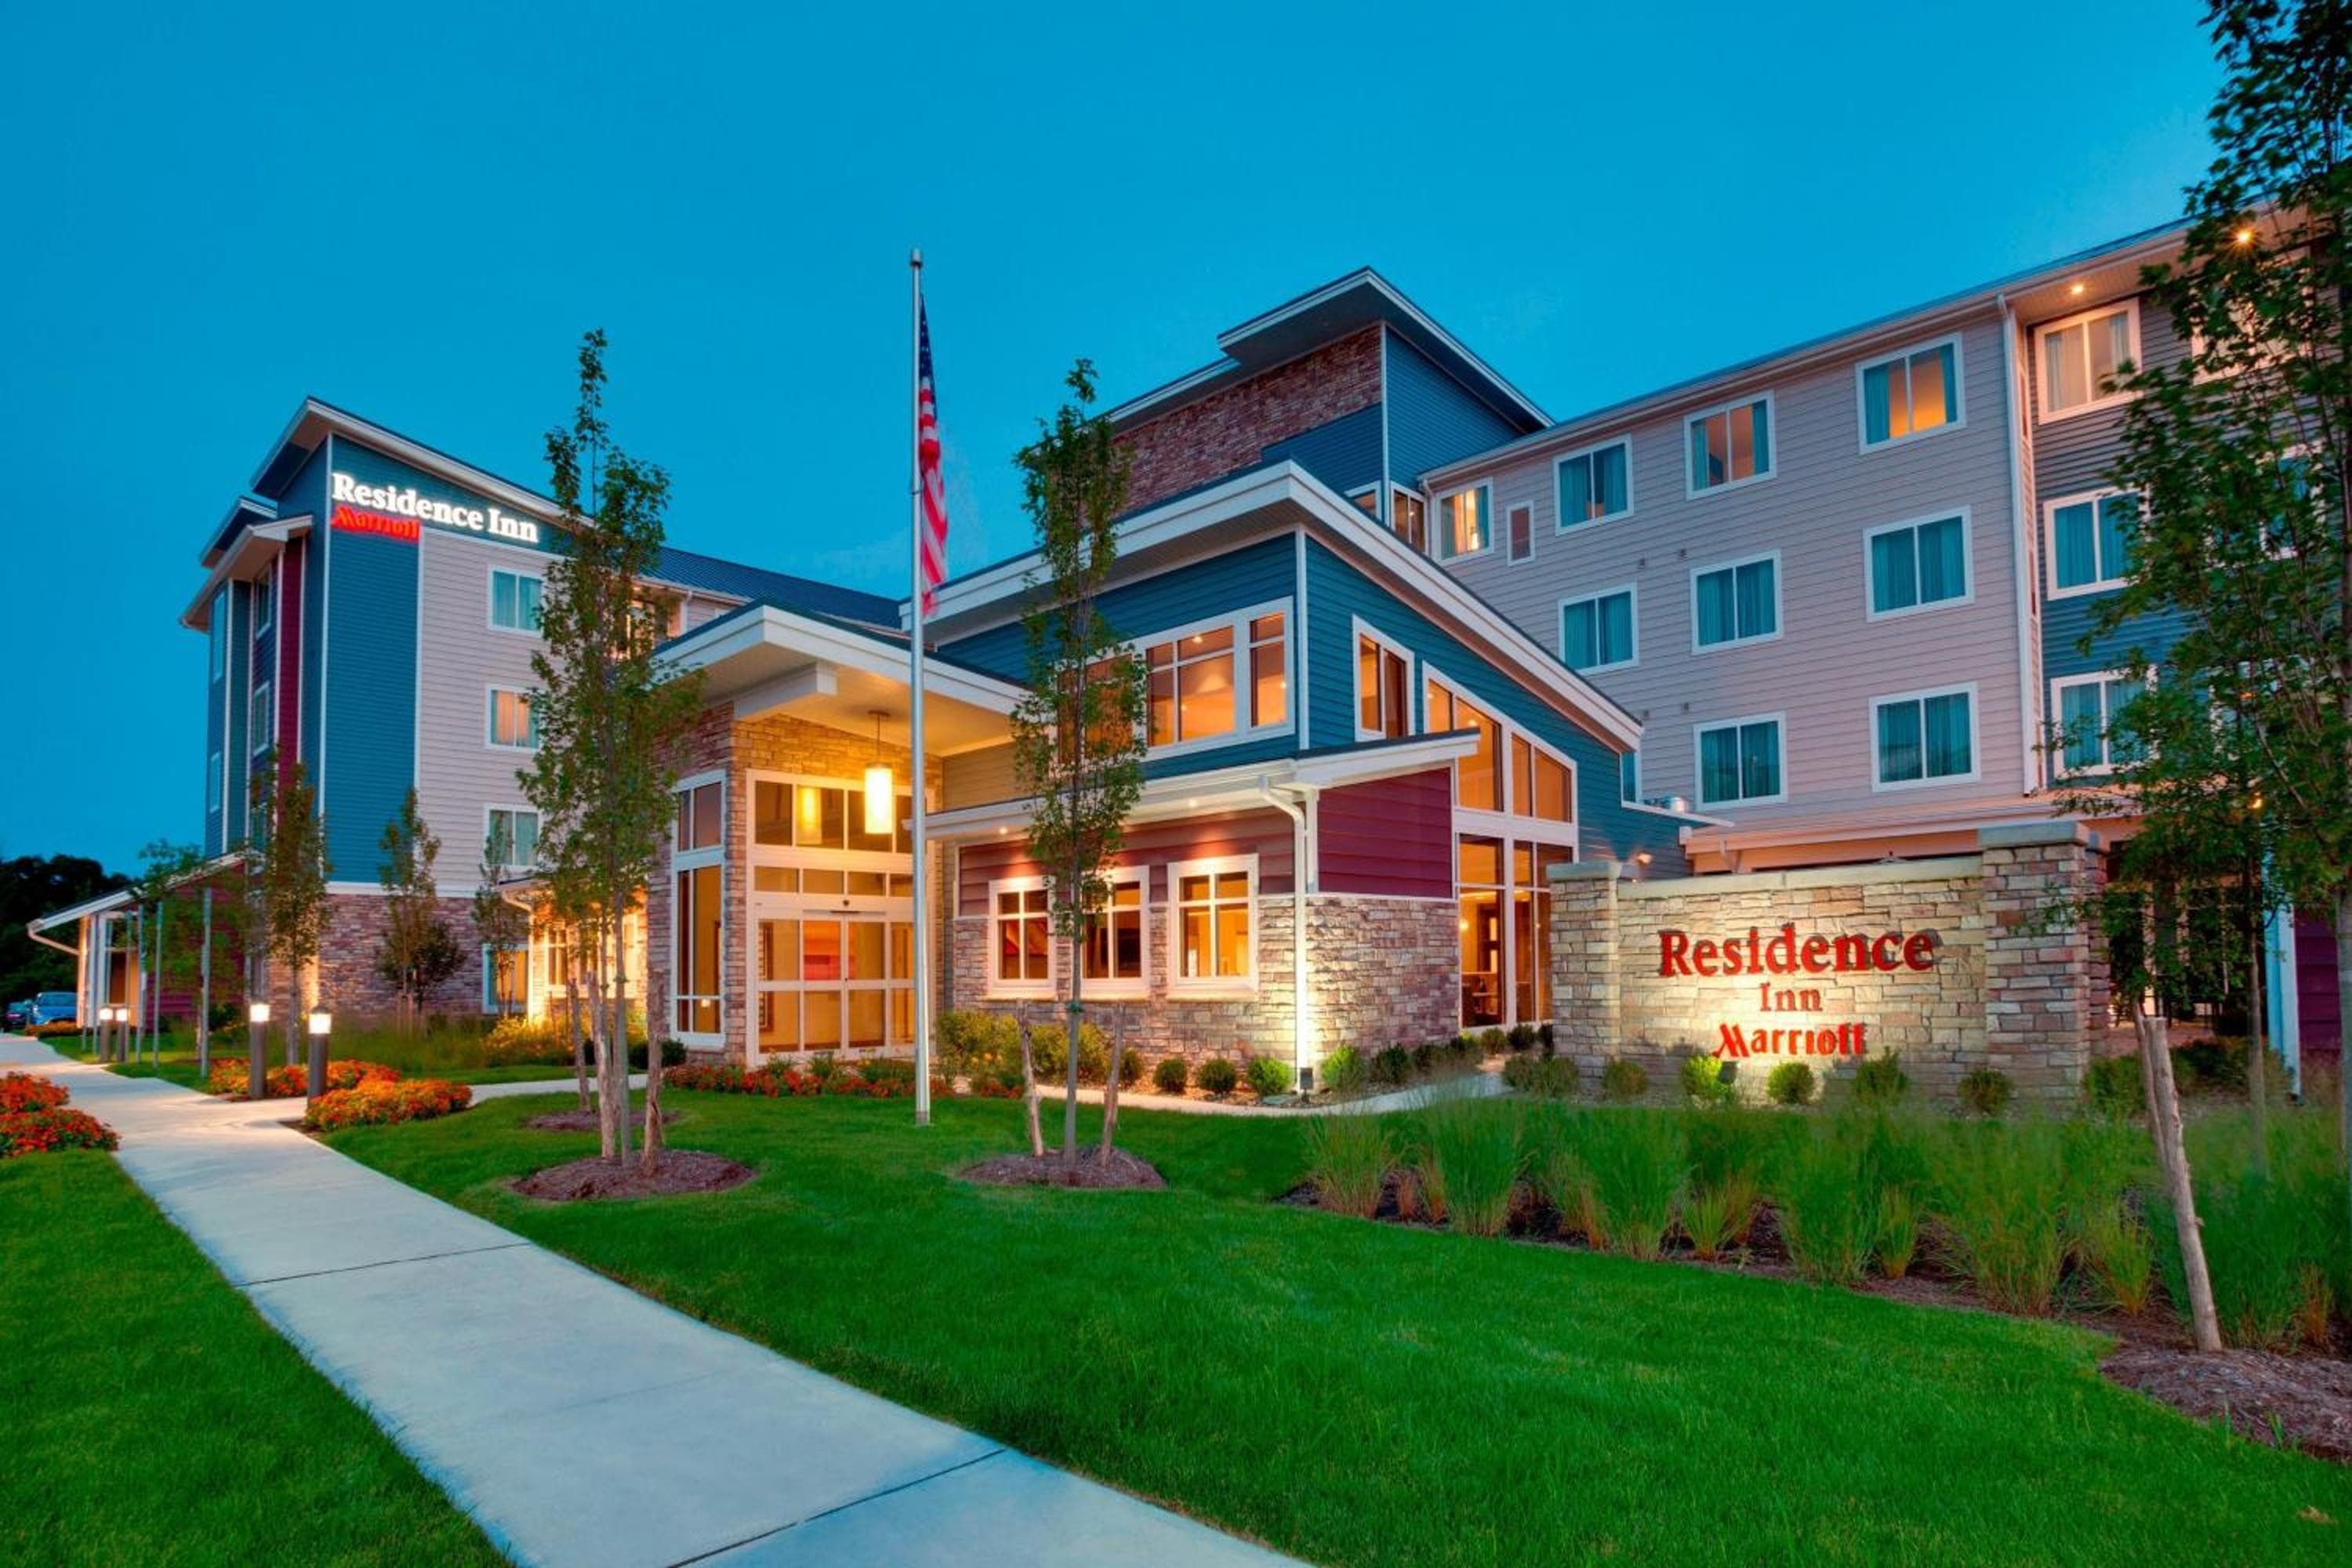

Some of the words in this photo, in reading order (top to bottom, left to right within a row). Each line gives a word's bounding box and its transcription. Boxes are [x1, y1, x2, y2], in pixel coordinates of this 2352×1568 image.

[332, 473, 484, 529] Residence
[488, 507, 538, 543] Inn
[332, 506, 420, 541] Marriott
[1658, 924, 1935, 977] Residence
[1760, 982, 1821, 1011] Inn
[1713, 1023, 1867, 1058] Marriott
